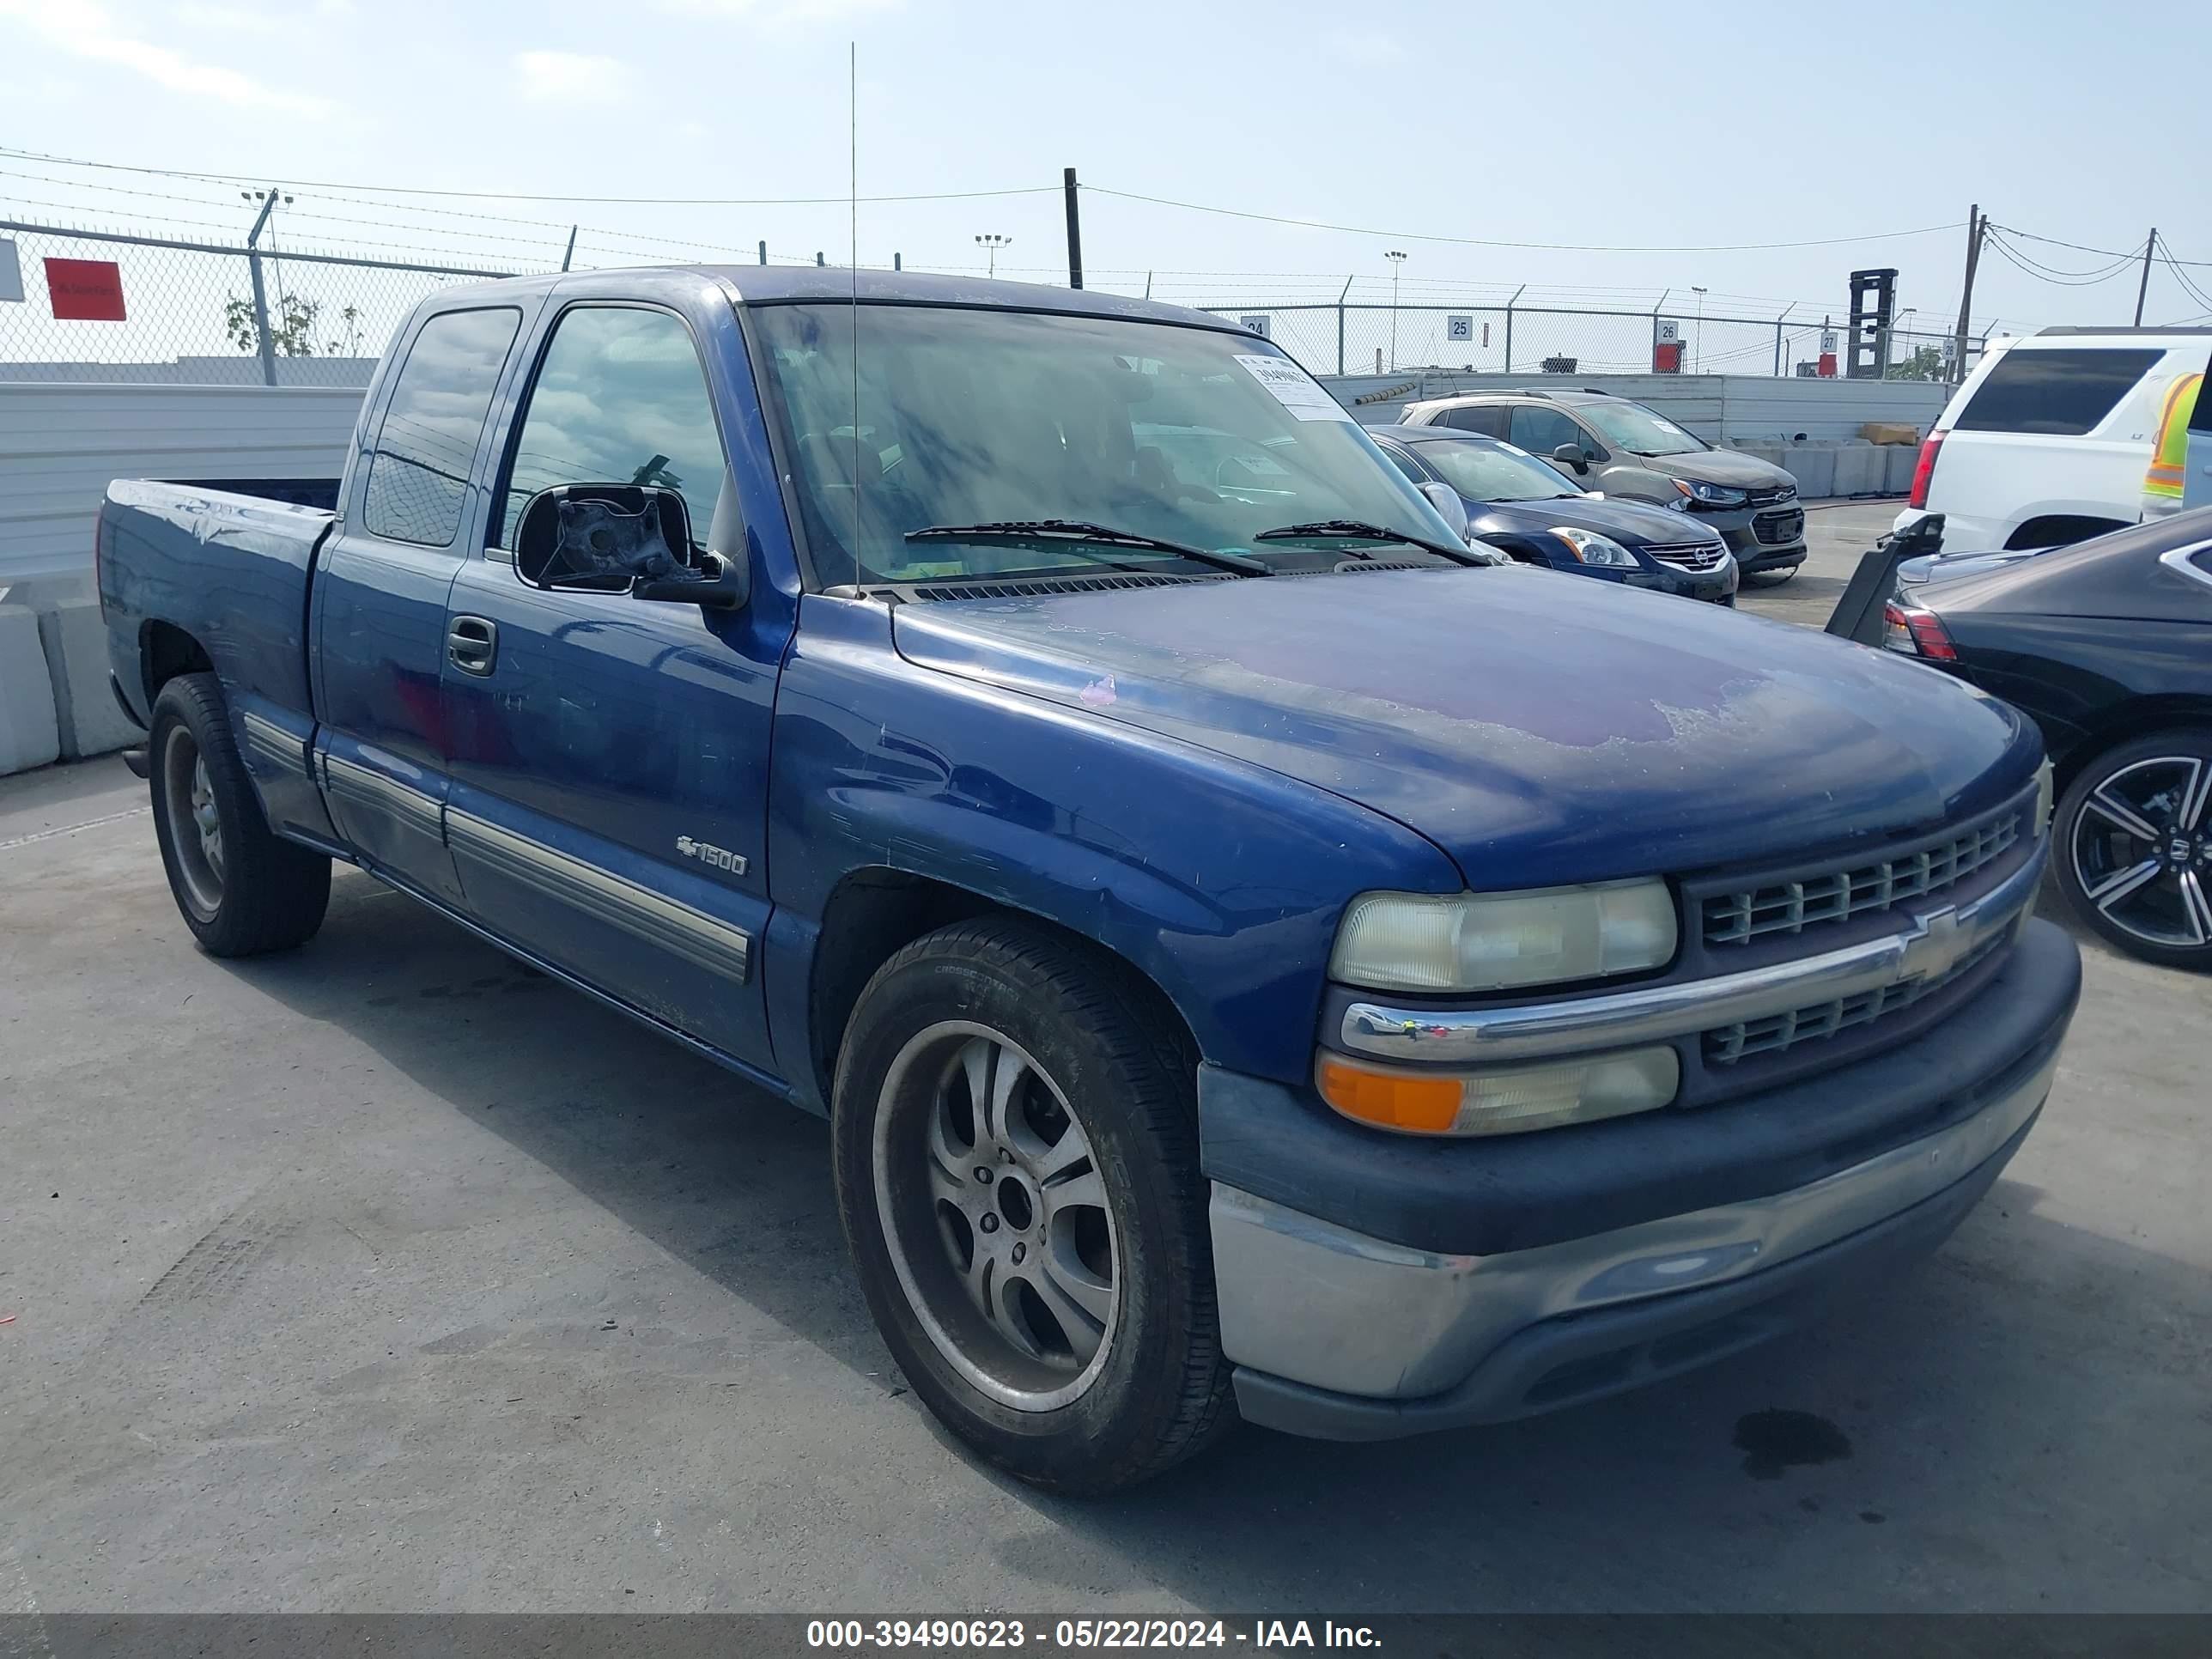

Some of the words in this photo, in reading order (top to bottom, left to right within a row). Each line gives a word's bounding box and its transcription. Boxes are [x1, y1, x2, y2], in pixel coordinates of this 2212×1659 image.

[1454, 321, 1467, 335] 25
[1662, 325, 1674, 338] 26
[1824, 337, 1834, 349] 27
[700, 842, 748, 876] 1500
